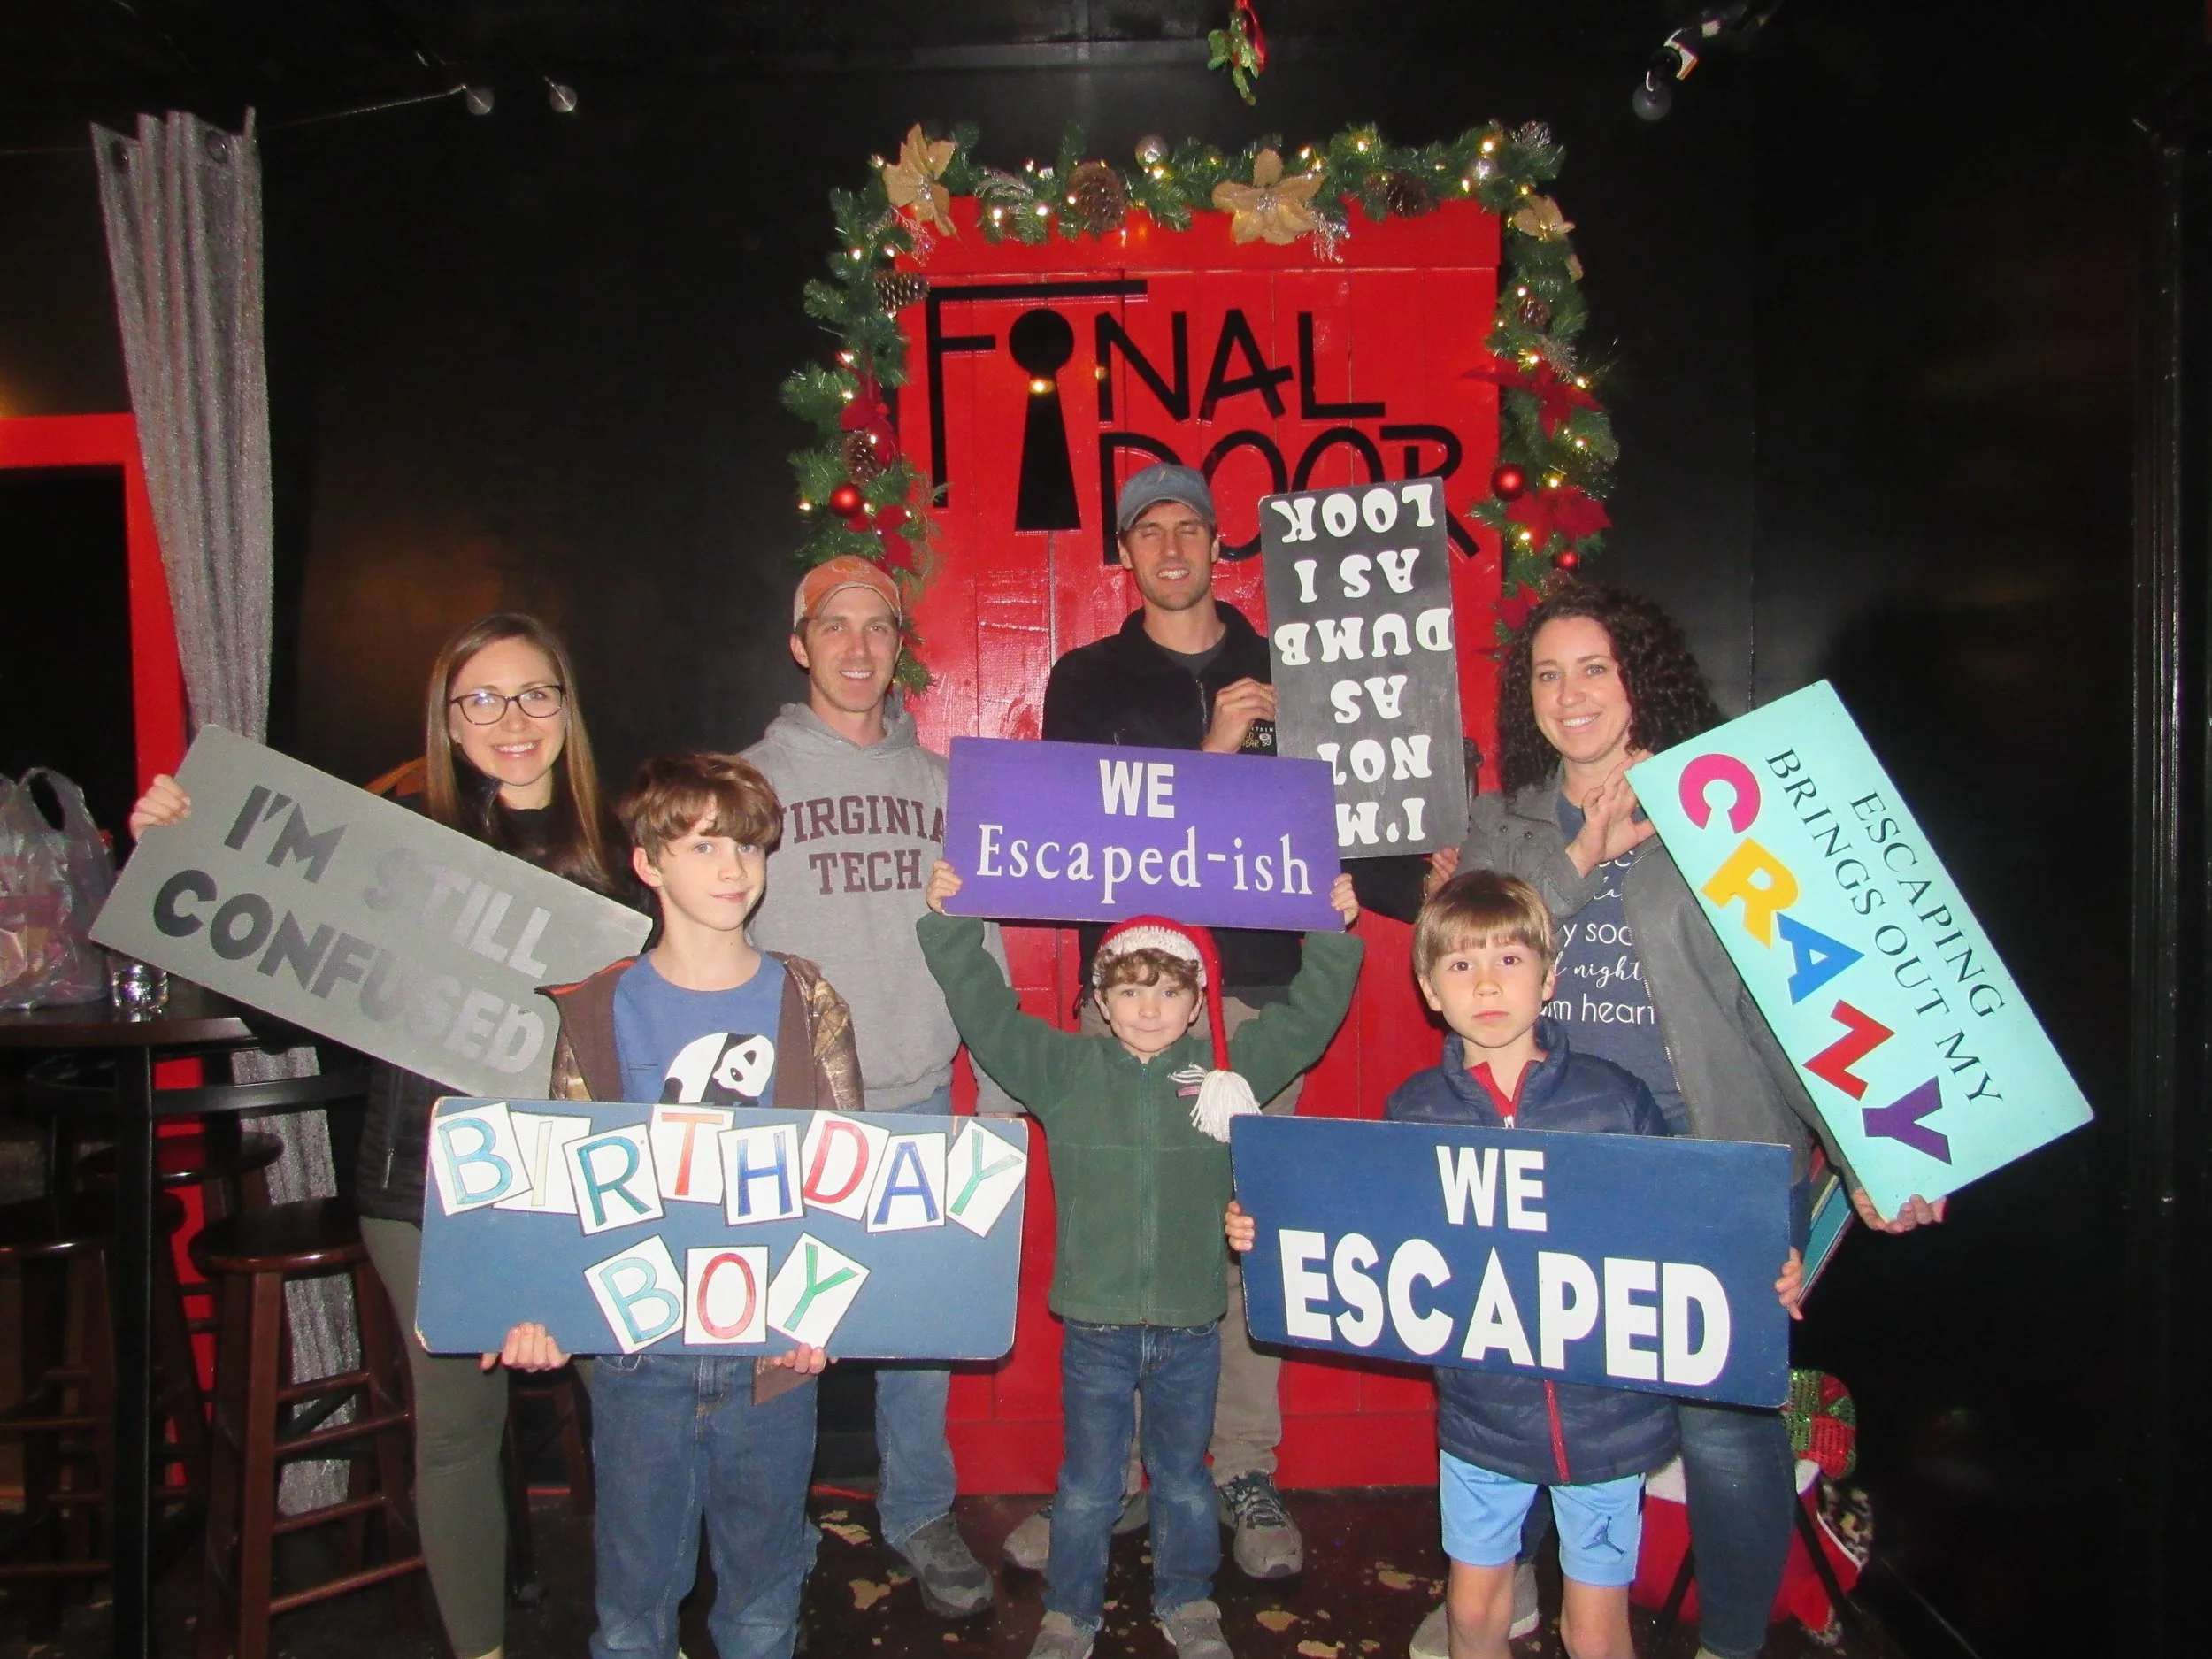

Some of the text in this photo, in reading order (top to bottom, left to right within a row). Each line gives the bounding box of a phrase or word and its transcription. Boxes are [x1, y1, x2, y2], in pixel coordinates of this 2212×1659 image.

[927, 280, 1386, 532] FINAL
[1271, 483, 1436, 543] LOOK
[1294, 548, 1420, 603] AS I
[1274, 608, 1453, 666] DUMB
[1330, 675, 1408, 724] AS
[781, 795, 945, 844] IRGINIA
[1099, 759, 1175, 818] WE
[1335, 797, 1425, 847] I'M
[224, 784, 552, 979] I'M STILL
[809, 849, 923, 895] TECH
[976, 824, 1313, 904] Escaped-ish
[1849, 791, 2006, 1019] ESCAPING
[1678, 752, 1953, 1166] CRAZY
[1765, 747, 2004, 1104] BRINGS OUT MY
[153, 868, 546, 1074] CONFUSED
[437, 1111, 1024, 1227] BIRTHDAY
[1435, 1145, 1548, 1232] WE
[598, 1242, 858, 1345] BOY
[1279, 1228, 1732, 1386] ESCAPED
